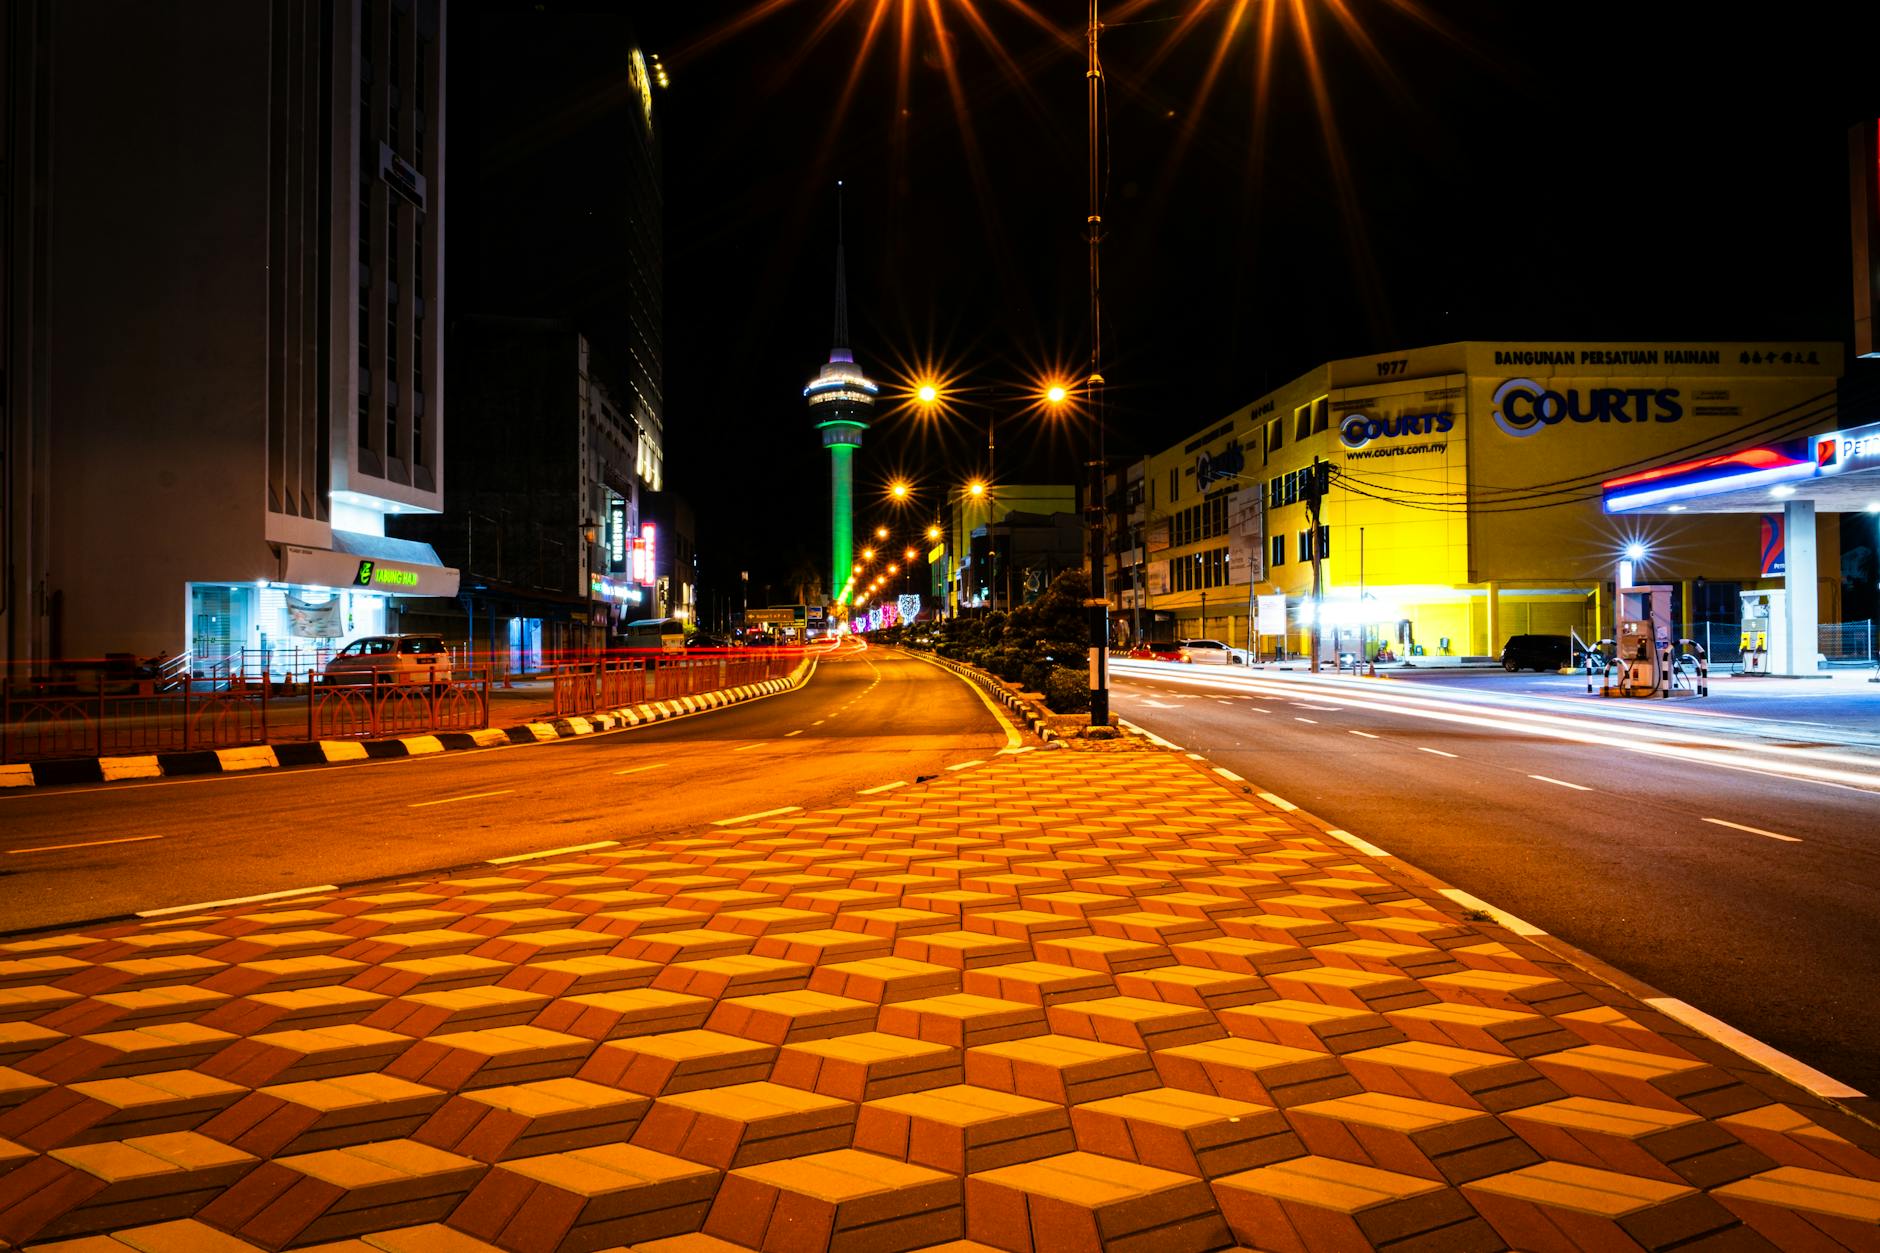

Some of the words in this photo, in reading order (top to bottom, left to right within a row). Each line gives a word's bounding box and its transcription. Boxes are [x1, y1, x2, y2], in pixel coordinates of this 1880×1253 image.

[1495, 351, 1575, 365] BANGUNAN
[1581, 351, 1658, 365] PERSATUAN
[1664, 351, 1720, 365] HAINAN
[1377, 359, 1408, 377] 1977
[1503, 388, 1683, 425] COURTS
[1346, 411, 1455, 441] COURTS
[1346, 443, 1447, 460] www.courts.com.my
[612, 510, 624, 562] SAMSUNG
[375, 568, 402, 584] TABUNG
